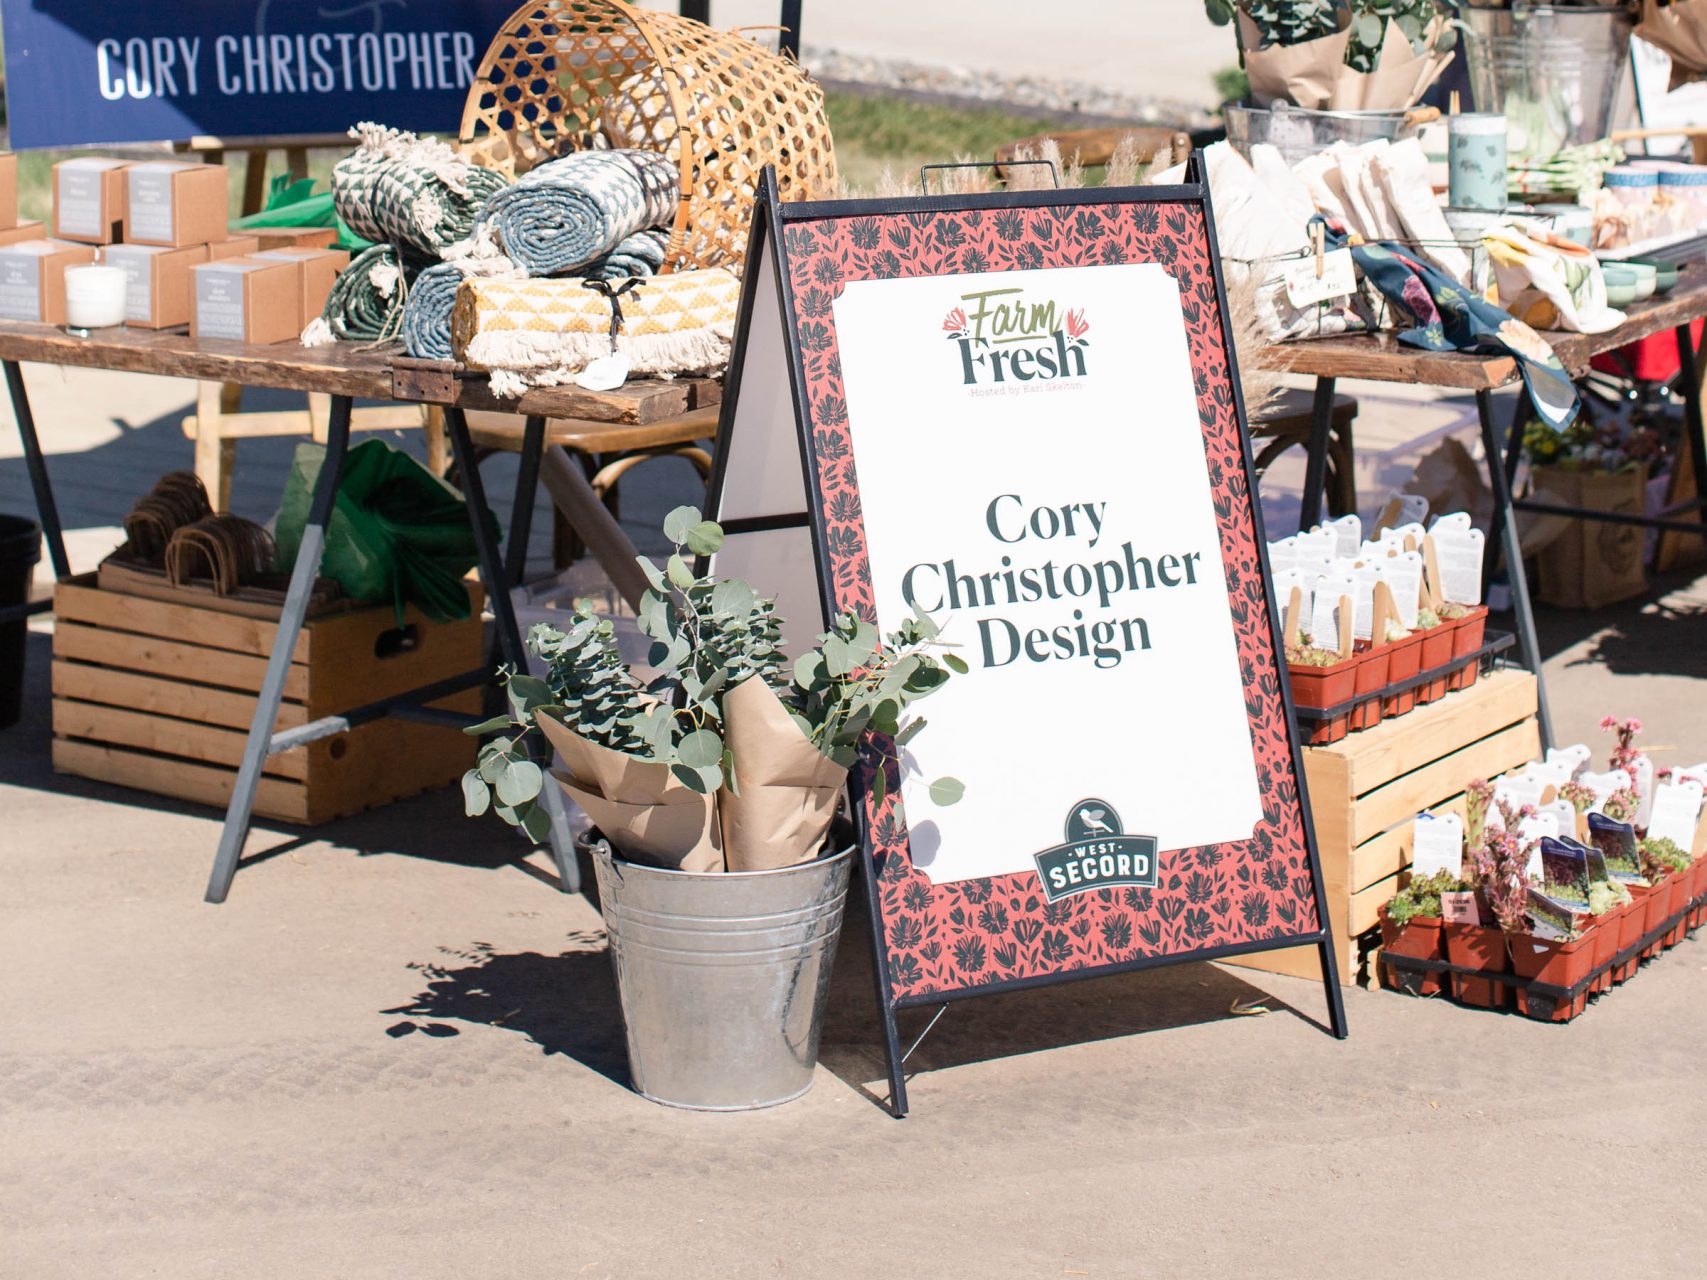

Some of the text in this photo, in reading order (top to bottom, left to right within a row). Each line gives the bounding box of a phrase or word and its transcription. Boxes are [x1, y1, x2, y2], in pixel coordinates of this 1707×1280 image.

[97, 30, 476, 100] CORY CHRISTOPHER
[961, 288, 1064, 348] Farm
[957, 329, 1087, 384] Fresh
[1008, 384, 1021, 396] by
[985, 494, 1106, 548] Cory
[901, 541, 1201, 613] Christopher
[977, 609, 1152, 668] Design
[1049, 854, 1149, 889] SECORD
[1075, 842, 1116, 858] WEST
